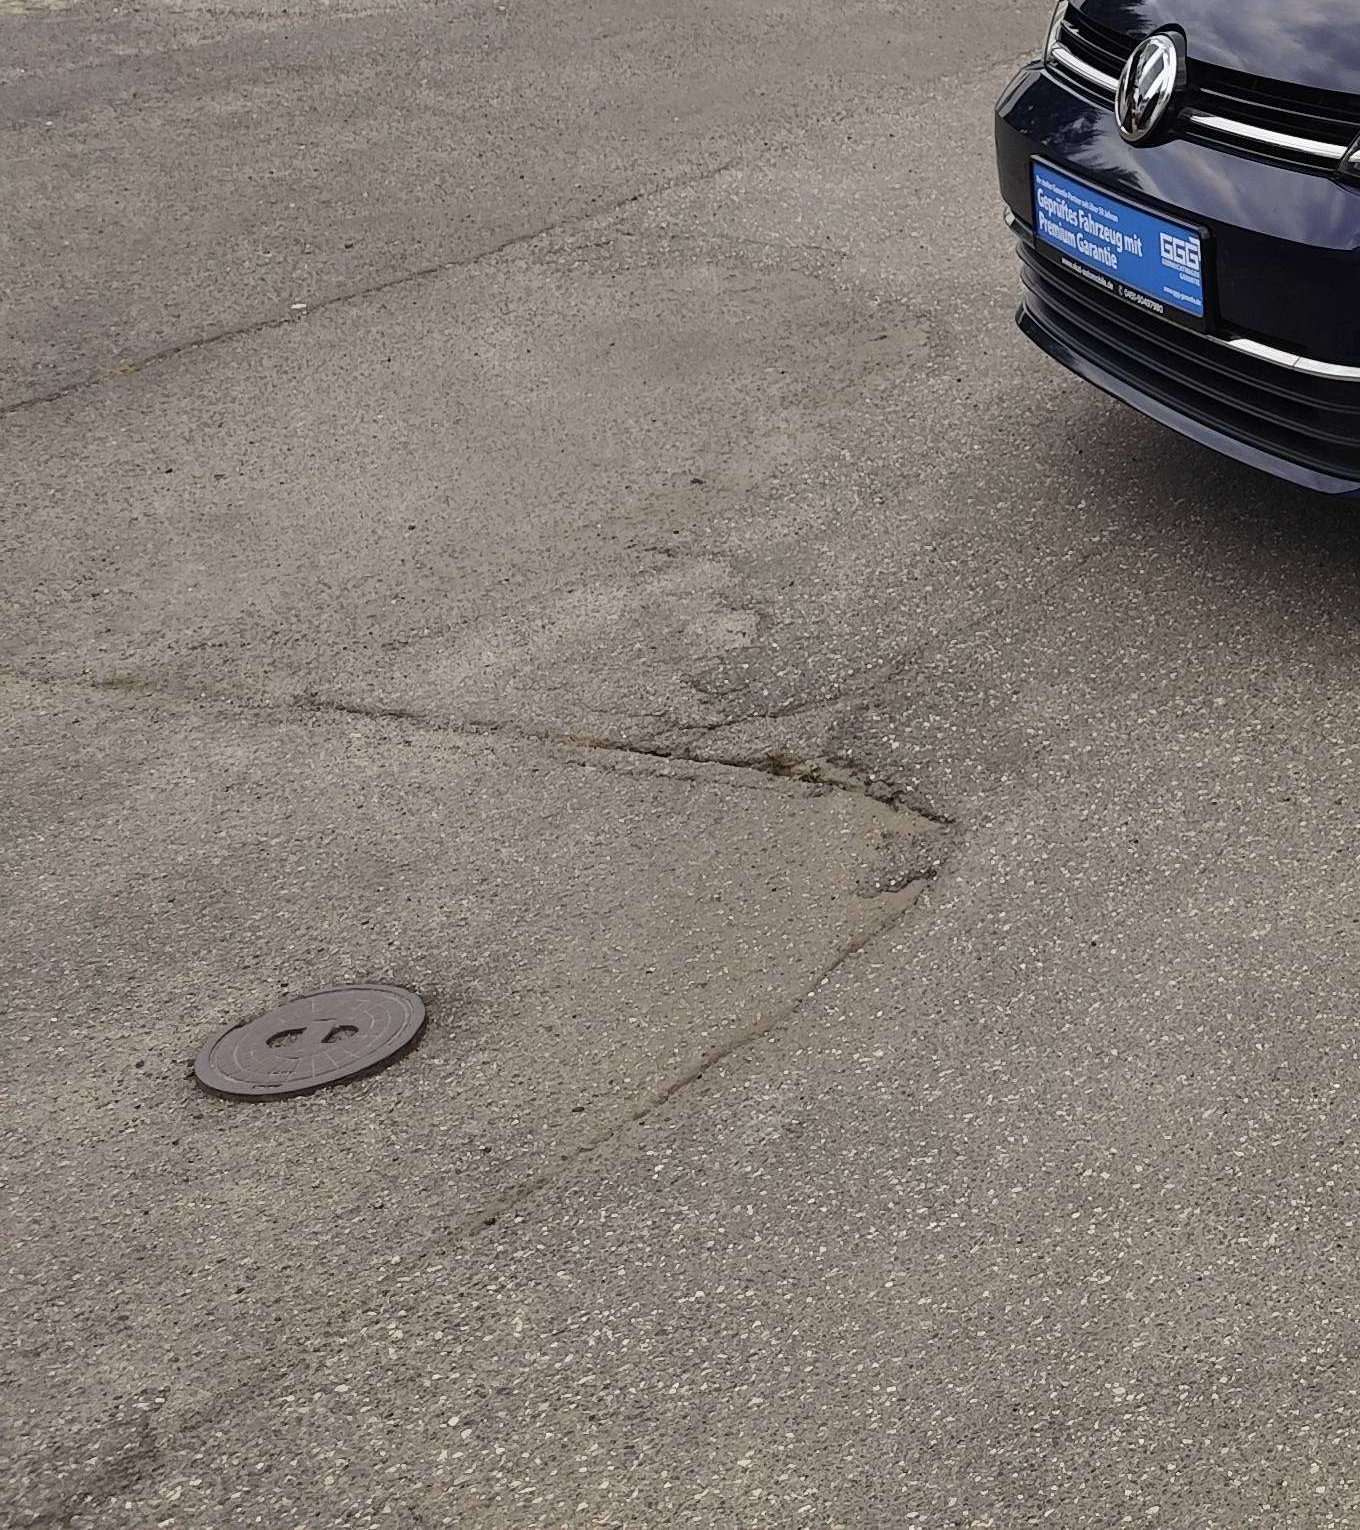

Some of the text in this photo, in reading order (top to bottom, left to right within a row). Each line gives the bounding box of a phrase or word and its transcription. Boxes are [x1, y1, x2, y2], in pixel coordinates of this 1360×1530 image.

[1037, 188, 1143, 257] Geprüftes Fahrzeug mit
[1038, 210, 1118, 269] Premium Garantie
[1160, 232, 1201, 271] GGG
